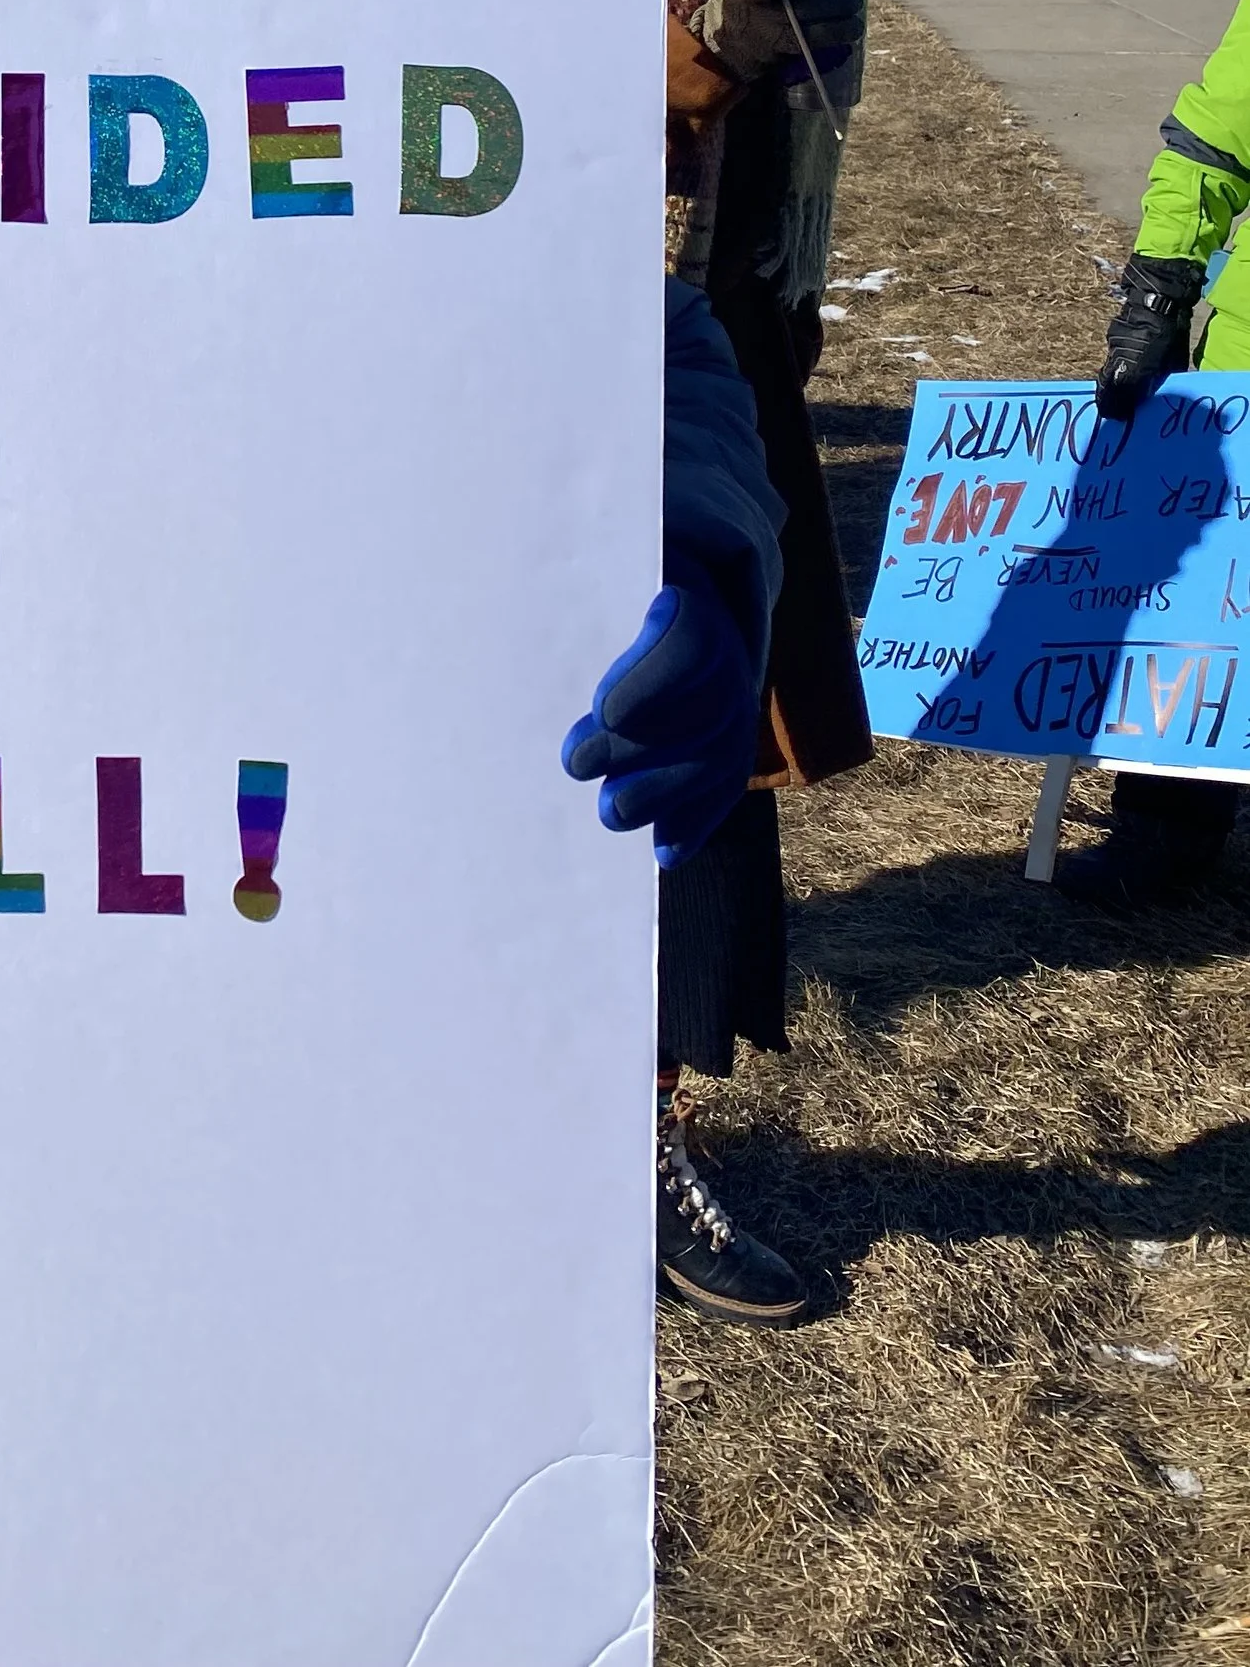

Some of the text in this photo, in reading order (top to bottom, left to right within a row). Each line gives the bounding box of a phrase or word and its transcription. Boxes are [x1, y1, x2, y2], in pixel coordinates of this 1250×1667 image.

[927, 394, 1249, 470] OUR COUNTRY
[902, 471, 1027, 545] LOVE
[1032, 478, 1129, 529] THAN
[902, 556, 1101, 603] NEVER BE
[1069, 580, 1178, 612] SHOULD
[860, 637, 999, 679] ANOTHER
[915, 691, 983, 736] FOR
[1014, 654, 1238, 747] HATRED
